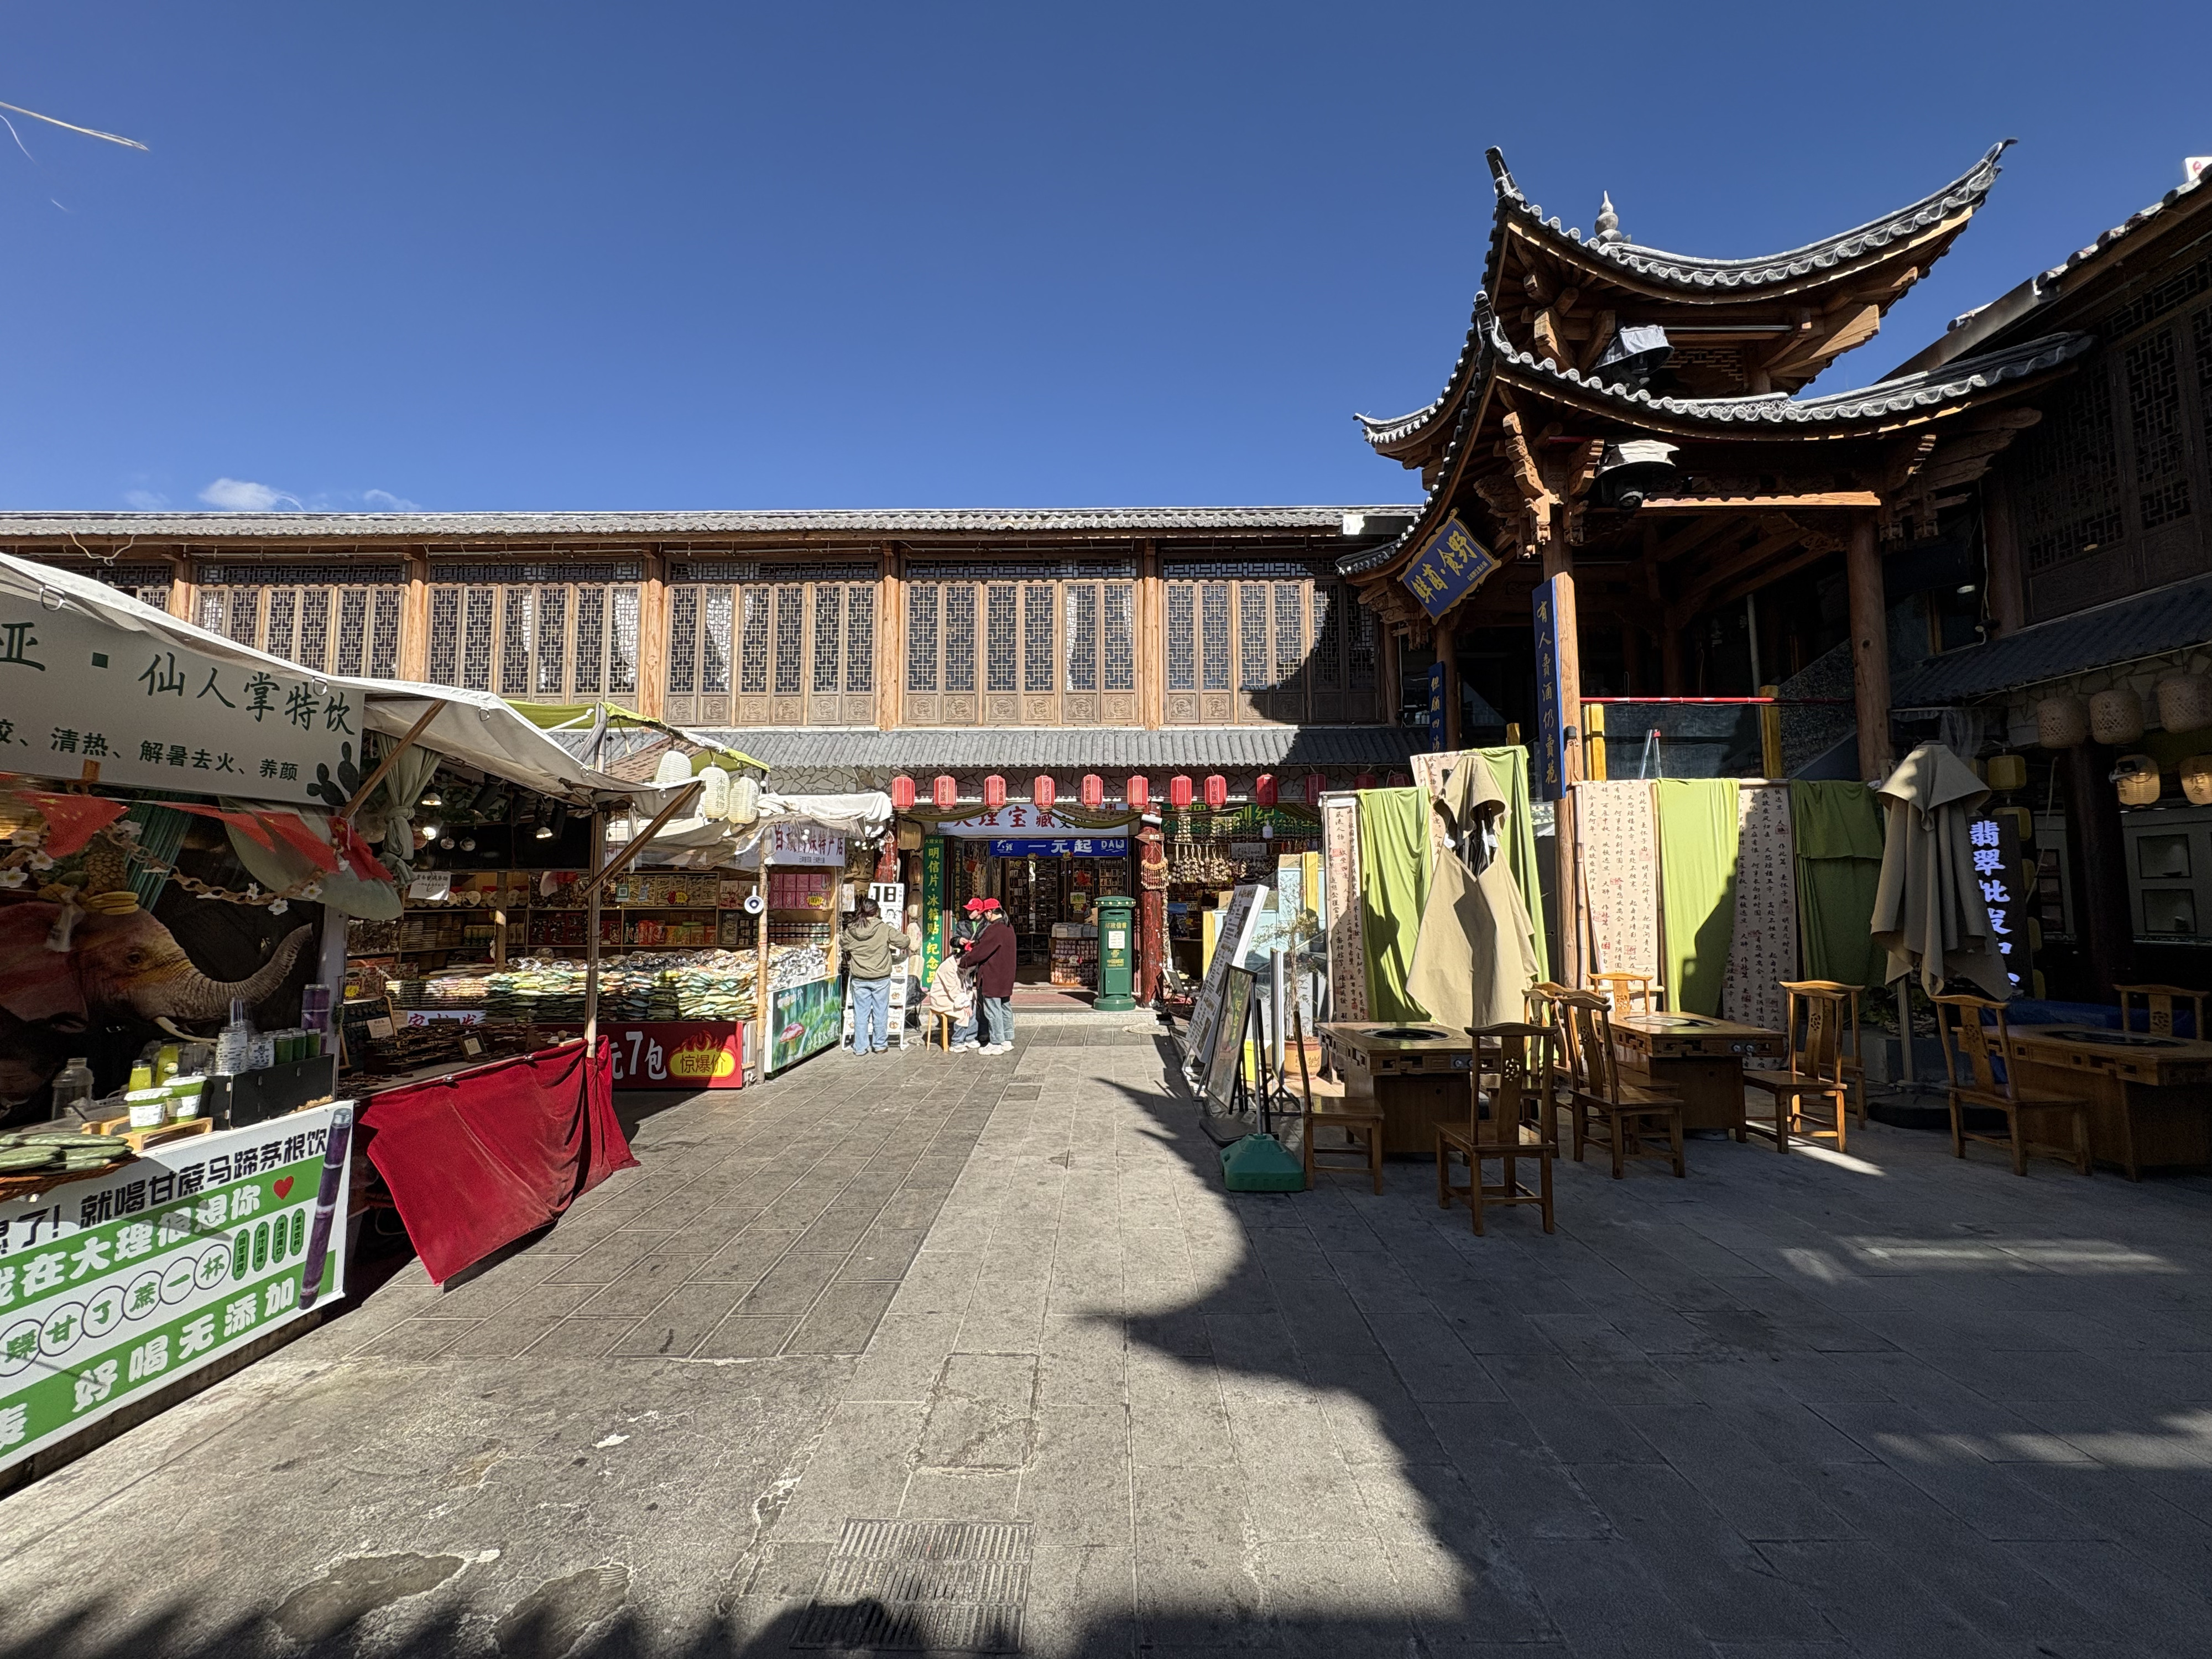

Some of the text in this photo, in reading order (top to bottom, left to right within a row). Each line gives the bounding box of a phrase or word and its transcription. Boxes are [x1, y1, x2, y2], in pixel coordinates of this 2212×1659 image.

[1028, 839, 1092, 854] 一元起
[873, 885, 897, 902] 18
[680, 1053, 726, 1074] 惊爆价
